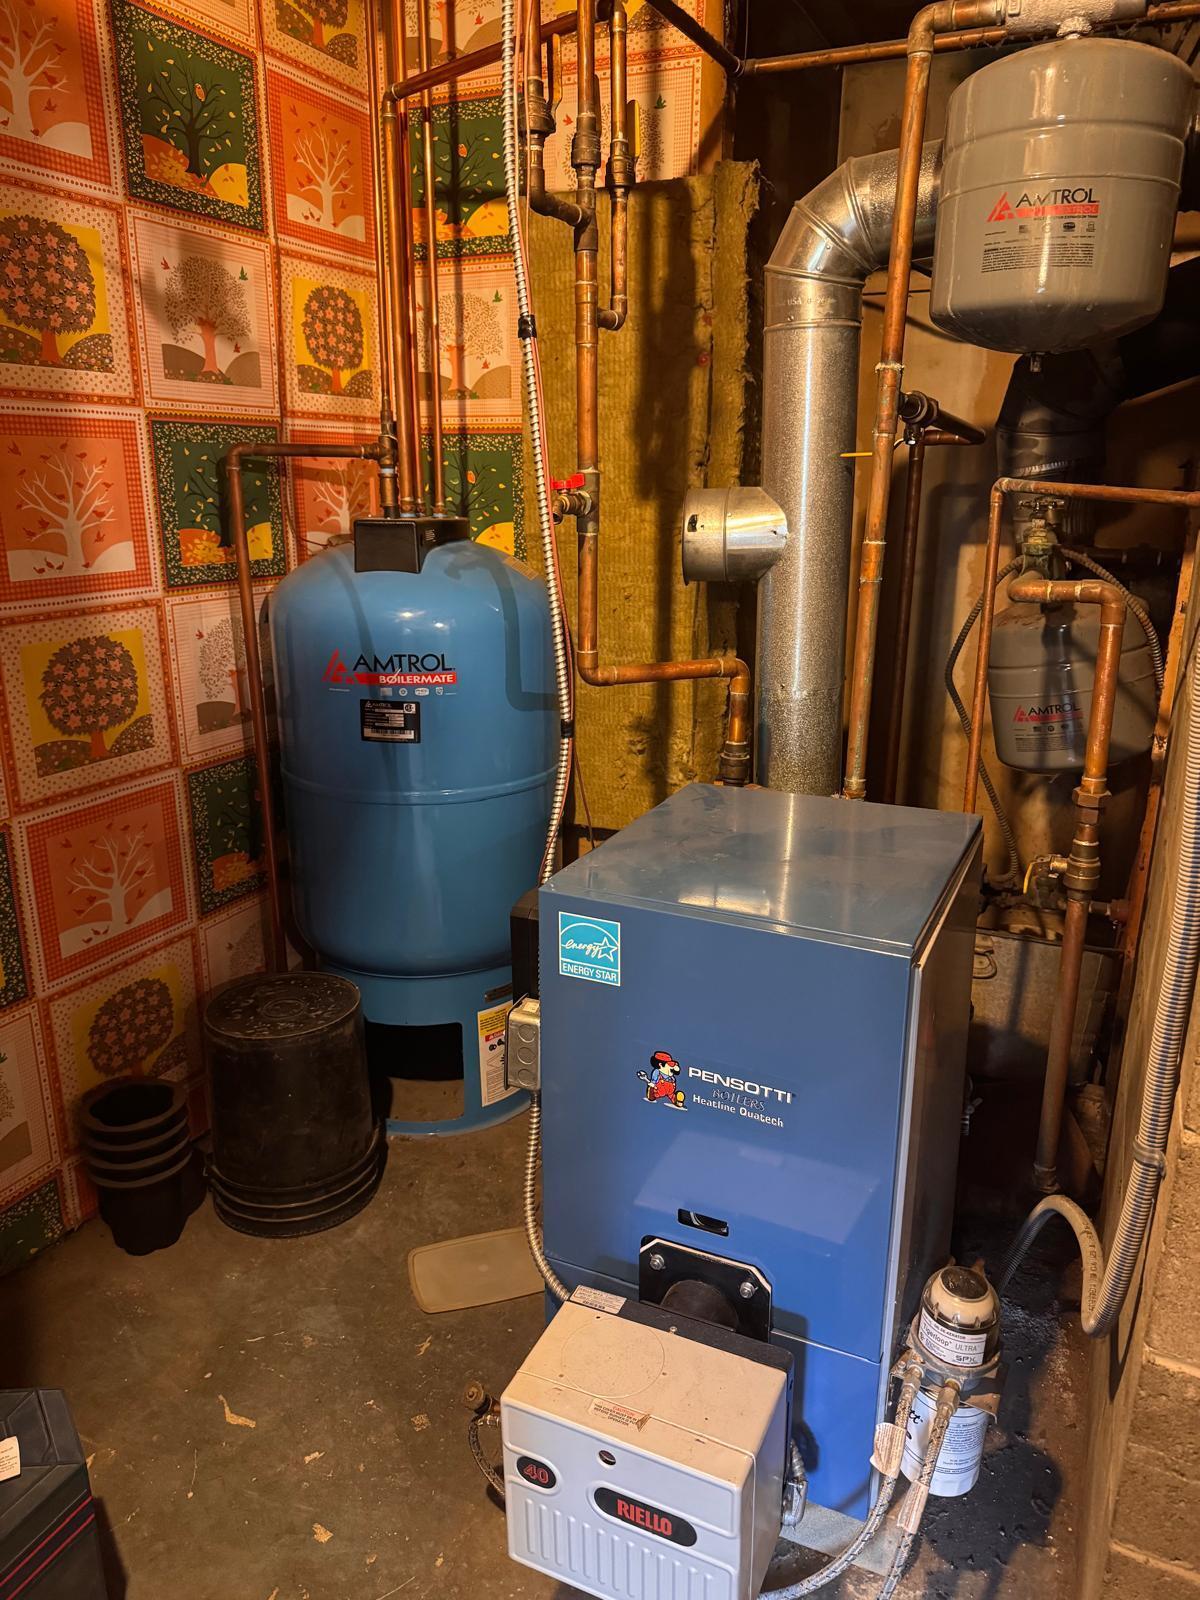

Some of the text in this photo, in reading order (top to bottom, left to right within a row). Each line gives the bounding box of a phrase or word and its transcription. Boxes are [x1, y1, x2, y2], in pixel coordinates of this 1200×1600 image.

[1015, 188, 1098, 208] AMTROL
[353, 653, 452, 672] AMTROL
[379, 674, 454, 685] BOILERMATE
[1028, 703, 1081, 716] AMTROL
[563, 963, 617, 982] ENERGY STAR
[688, 1067, 792, 1104] PENSOTTI
[712, 1088, 766, 1112] BOILERS
[693, 1094, 784, 1128] Heatline Quatech
[955, 1343, 977, 1352] ULTRA
[523, 1463, 550, 1484] 40
[616, 1498, 673, 1536] RIELLO
